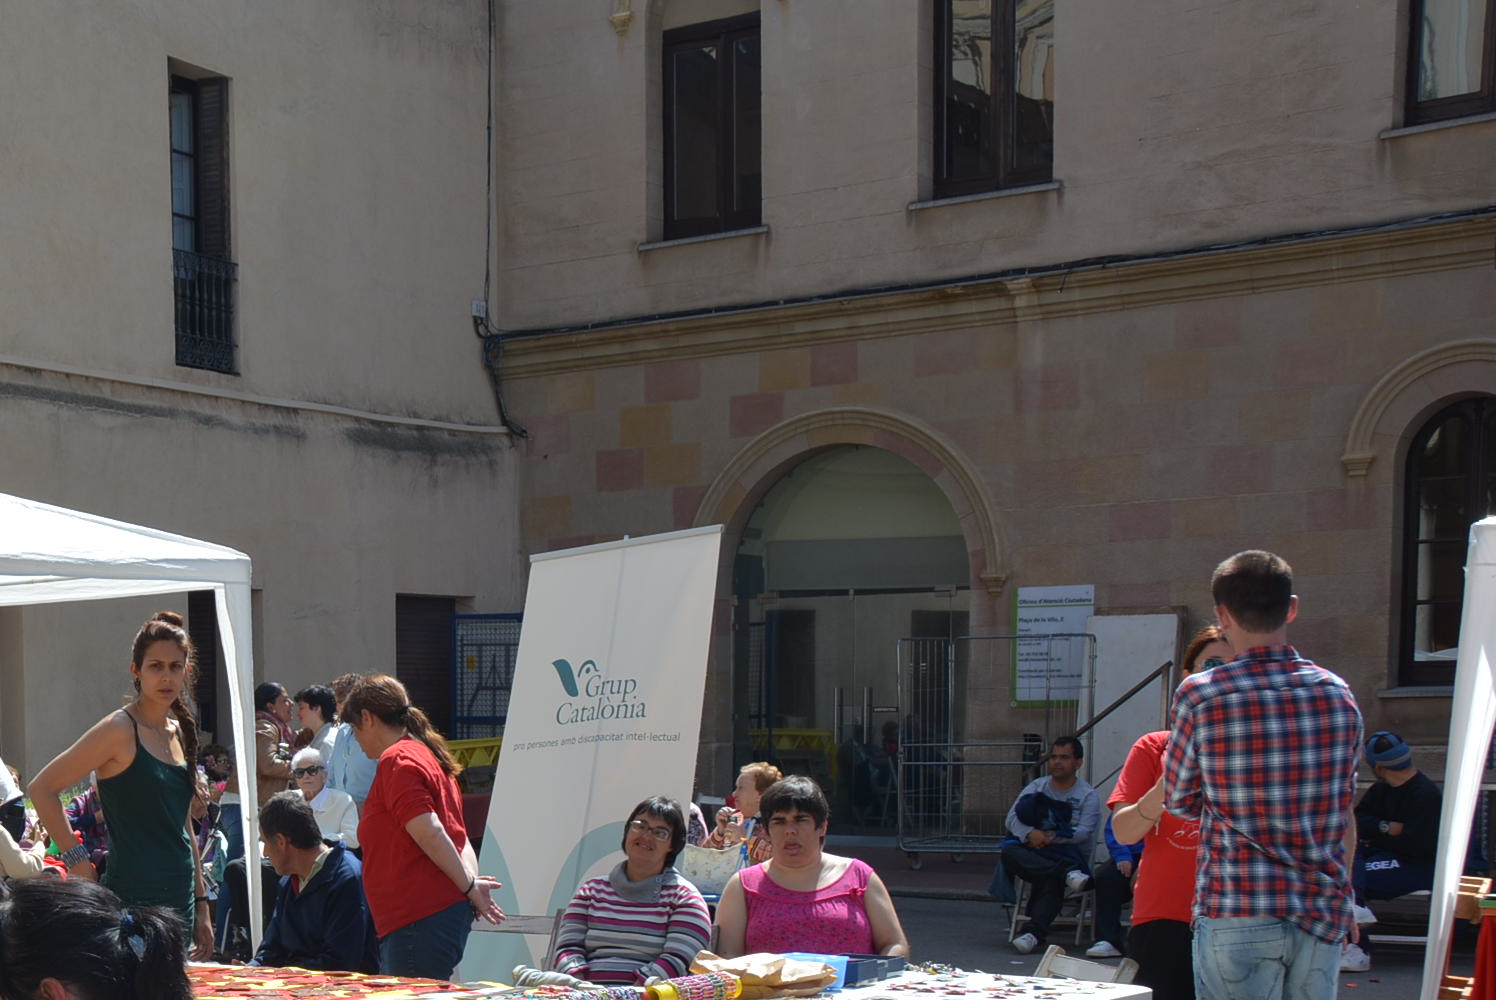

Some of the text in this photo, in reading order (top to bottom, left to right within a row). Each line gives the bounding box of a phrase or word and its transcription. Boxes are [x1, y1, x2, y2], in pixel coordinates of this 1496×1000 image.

[585, 674, 637, 703] Grup
[556, 695, 647, 725] Catalònia
[527, 739, 559, 751] persones
[561, 737, 577, 747] amb
[577, 733, 624, 745] discapacitat
